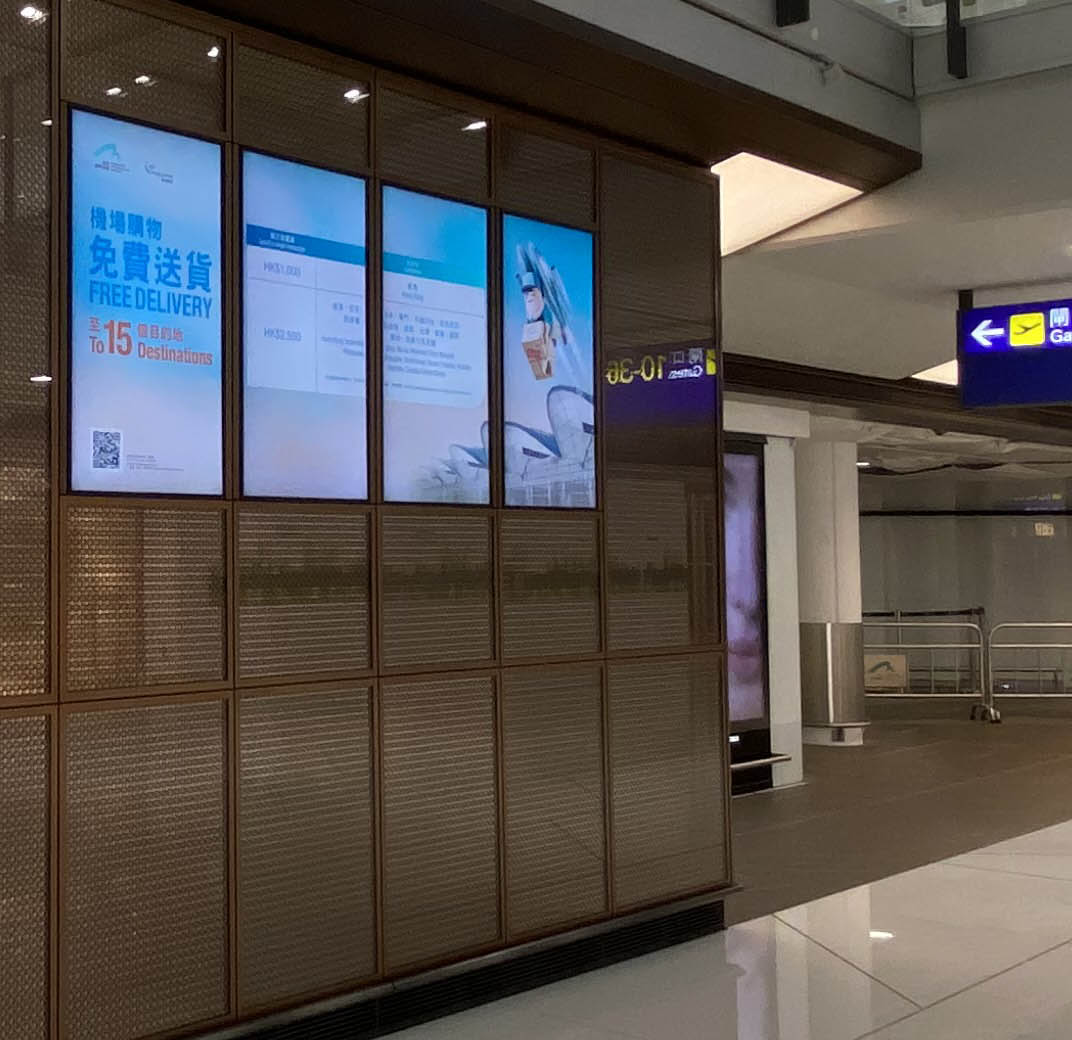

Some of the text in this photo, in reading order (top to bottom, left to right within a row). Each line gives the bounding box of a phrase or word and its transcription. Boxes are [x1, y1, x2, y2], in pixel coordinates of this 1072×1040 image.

[91, 205, 162, 241] 機場購物
[89, 234, 212, 293] 免費送貨
[89, 280, 213, 320] FREE DELIVERY
[89, 336, 213, 366] To Destinations
[103, 319, 133, 356] 15
